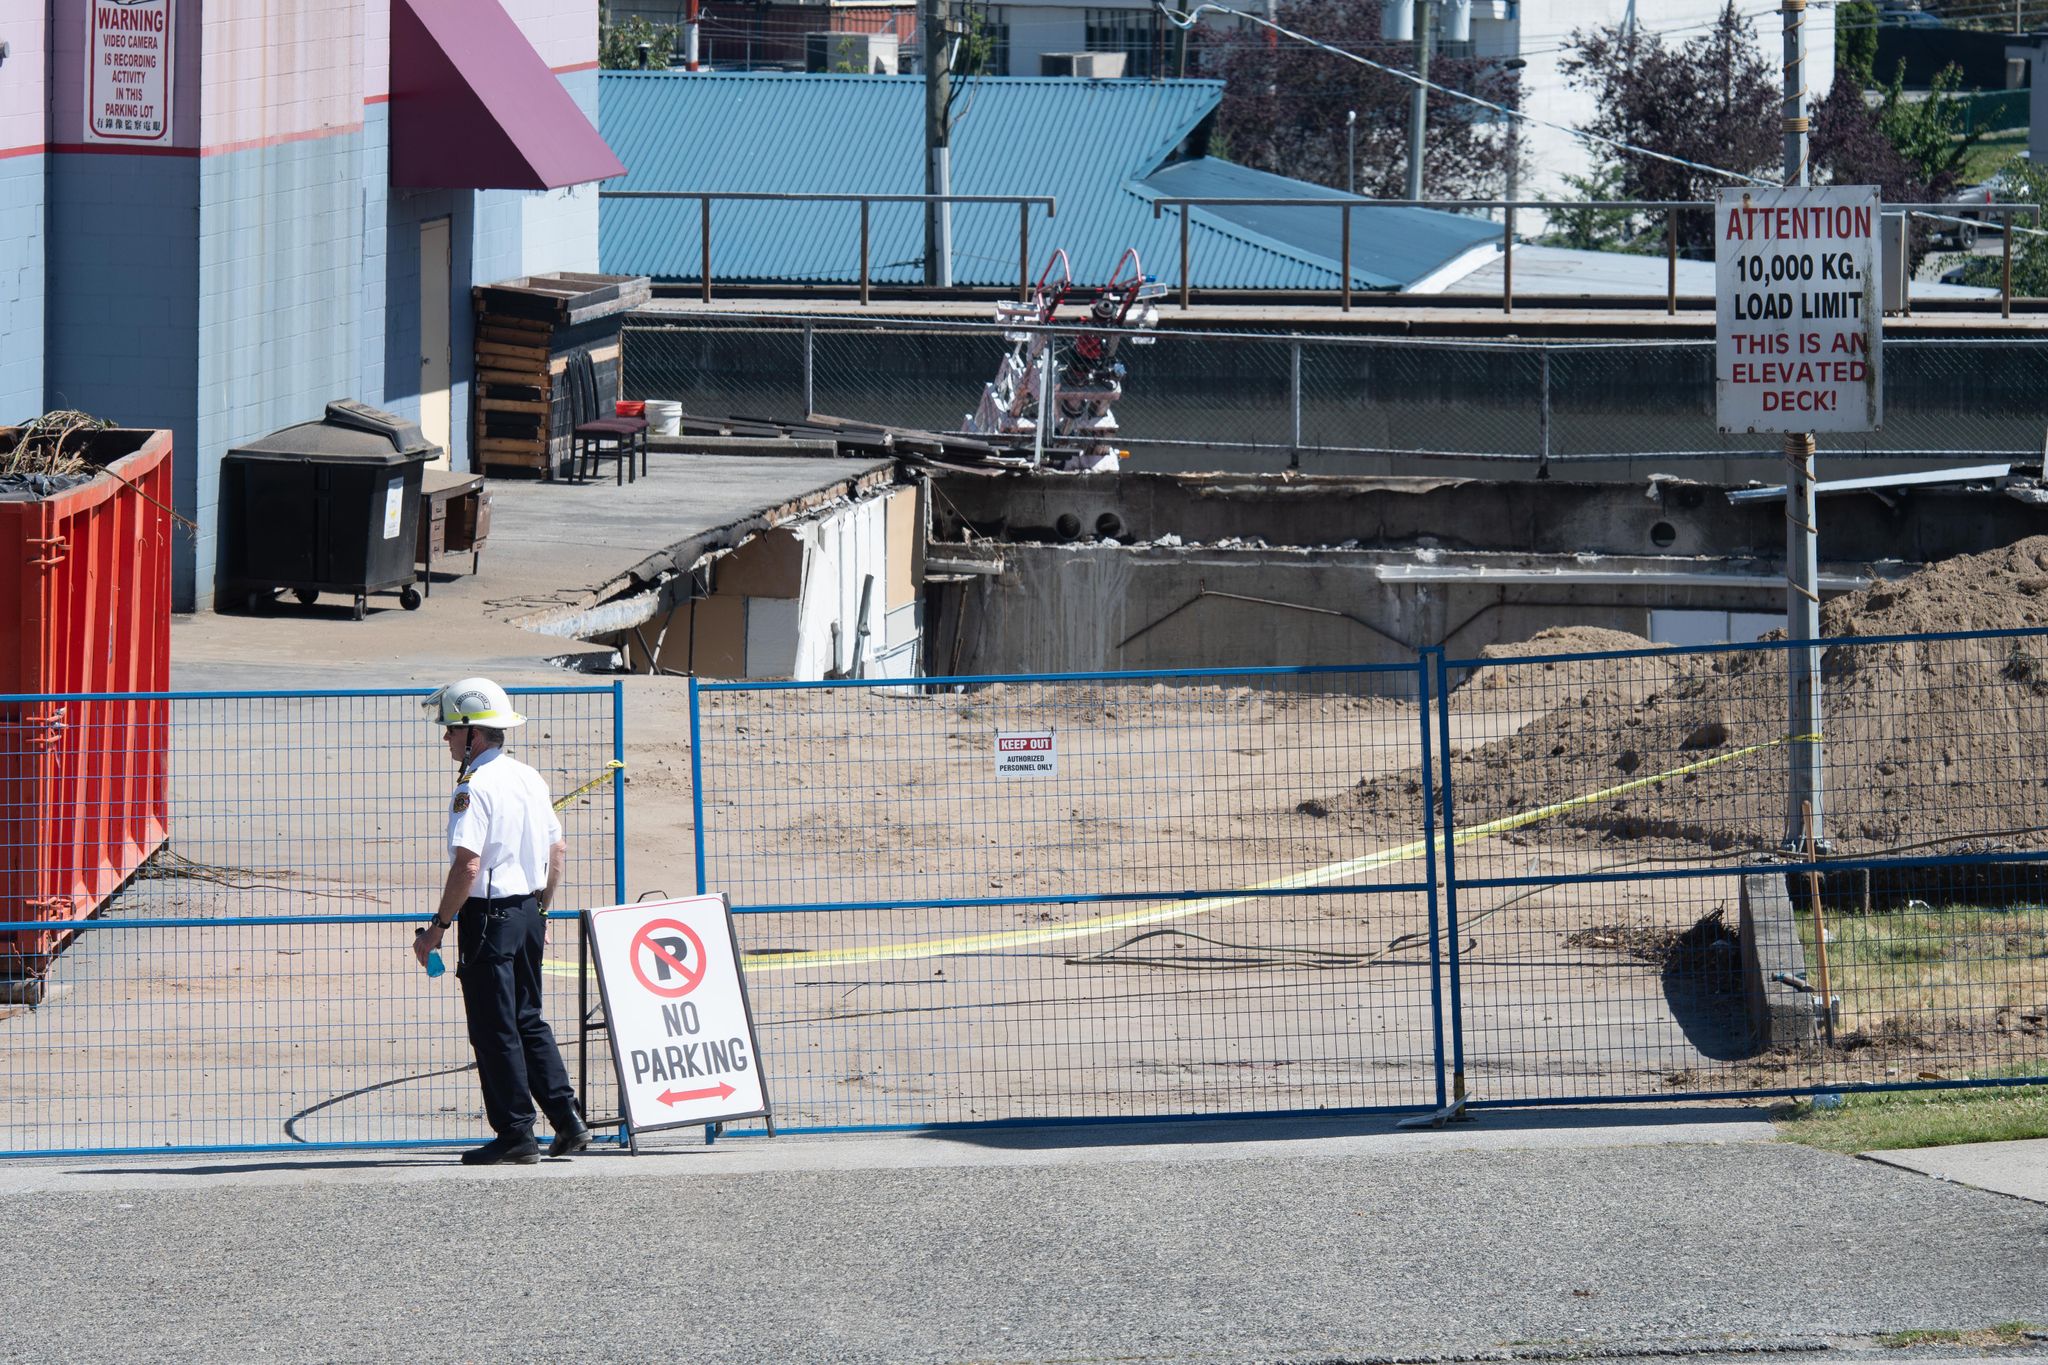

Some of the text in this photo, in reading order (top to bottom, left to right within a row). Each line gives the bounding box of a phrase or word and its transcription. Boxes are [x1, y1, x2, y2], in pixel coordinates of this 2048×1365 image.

[98, 7, 163, 32] WARNING
[103, 34, 158, 49] VIDEO CAMERA
[104, 53, 156, 68] IS RECORDING
[112, 70, 146, 84] ACTIVITY
[115, 87, 143, 101] IN THIS
[105, 103, 154, 118] PARKING LOT
[1726, 206, 1871, 240] ATTENTION
[1737, 252, 1861, 287] 10,000 KG.
[1735, 291, 1863, 320] LOAD LIMIT
[1731, 332, 1868, 355] THIS IS AN
[1732, 361, 1869, 383] ELEVATED
[1762, 390, 1837, 411] DECK!
[1001, 738, 1051, 750] KEEP OUT
[1037, 763, 1053, 771] ONLY
[661, 1001, 700, 1038] NO
[631, 1037, 748, 1084] PARKING
